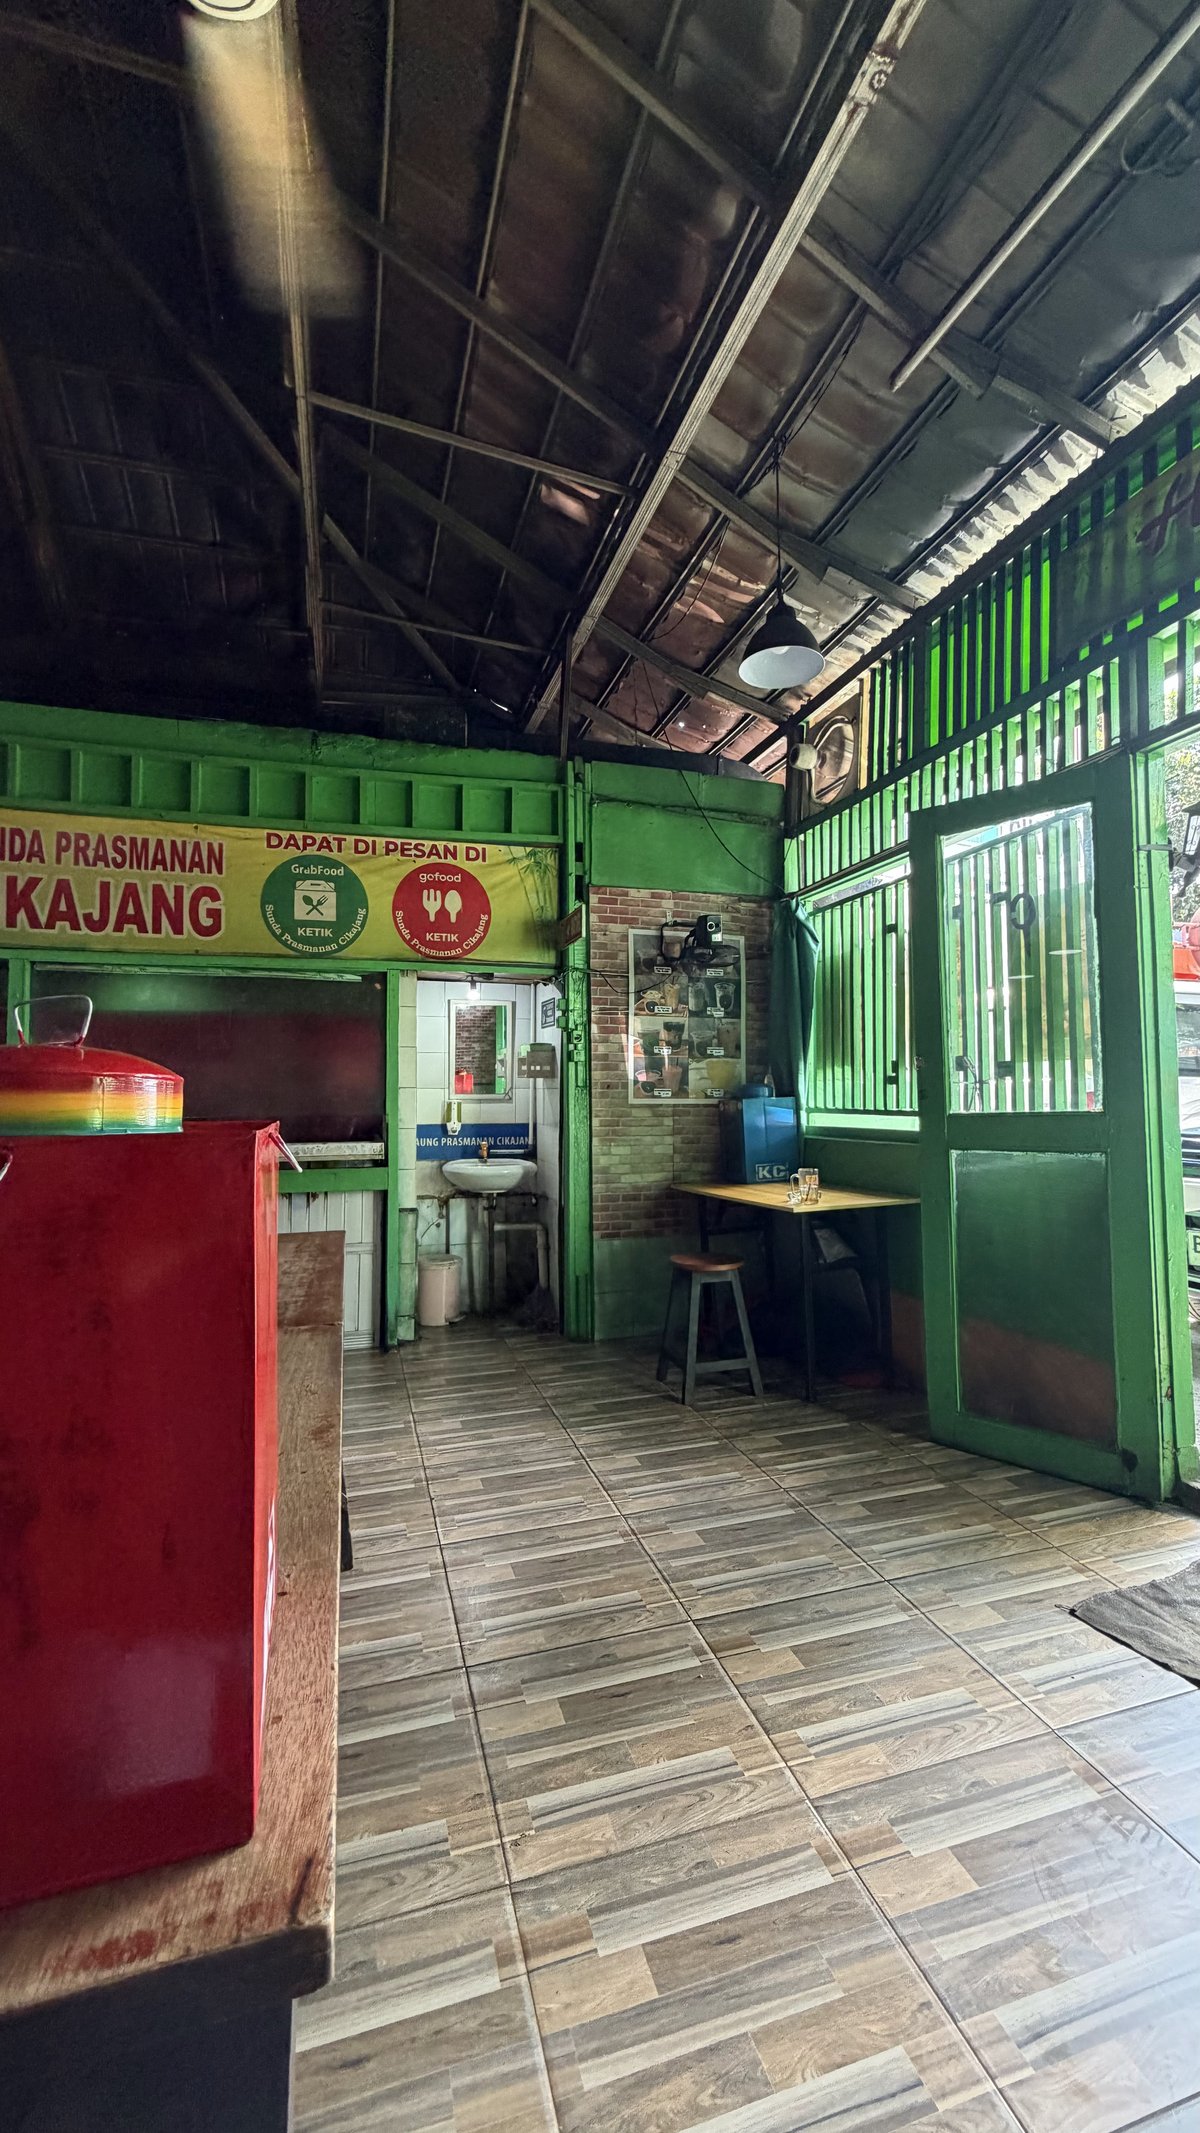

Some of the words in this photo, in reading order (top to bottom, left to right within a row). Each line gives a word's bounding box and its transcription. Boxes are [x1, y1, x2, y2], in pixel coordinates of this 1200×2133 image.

[55, 831, 224, 875] PRASMANAN
[265, 832, 347, 854] DAPAT
[353, 838, 377, 856] DI
[384, 841, 458, 861] PESAN
[464, 847, 488, 863] DI
[290, 863, 345, 876] GrabFood
[419, 872, 462, 883] gofood
[5, 875, 223, 938] KAJANG
[265, 904, 282, 935] Sunda
[281, 934, 338, 953] Prasmanan
[338, 907, 367, 946] Cikajang
[297, 927, 333, 938] KETIK
[395, 910, 411, 940] Sunda
[410, 938, 462, 957] Prasmanan
[462, 913, 489, 950] Cikajang
[426, 932, 459, 943] KETIK
[496, 1136, 531, 1146] CIKAJAN
